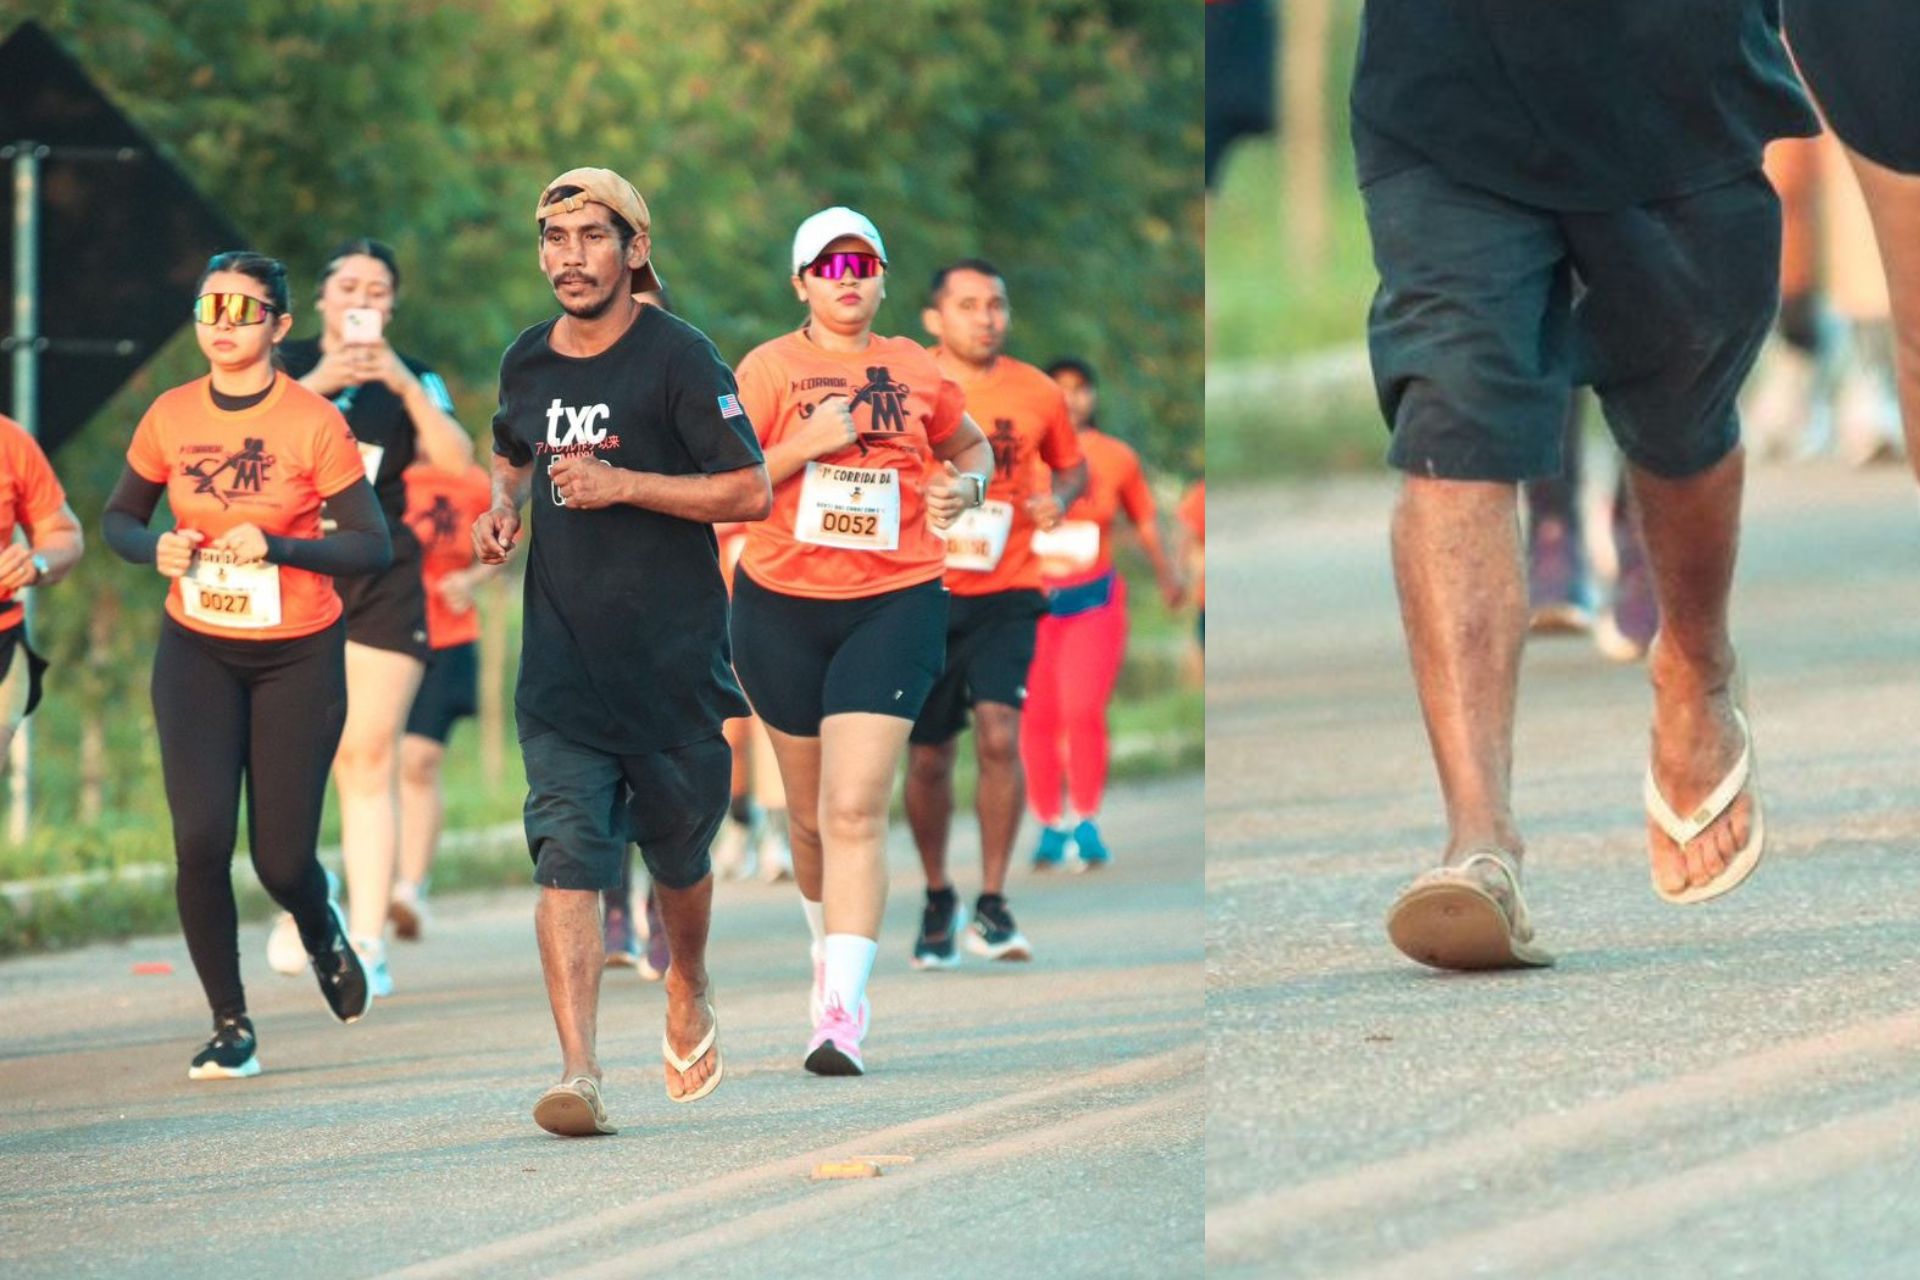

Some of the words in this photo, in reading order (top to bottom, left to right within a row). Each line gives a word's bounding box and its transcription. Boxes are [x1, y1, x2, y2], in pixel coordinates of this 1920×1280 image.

[546, 399, 610, 448] txc
[834, 469, 876, 484] CORRIDA
[823, 512, 877, 536] 0052
[200, 590, 248, 613] 0027
